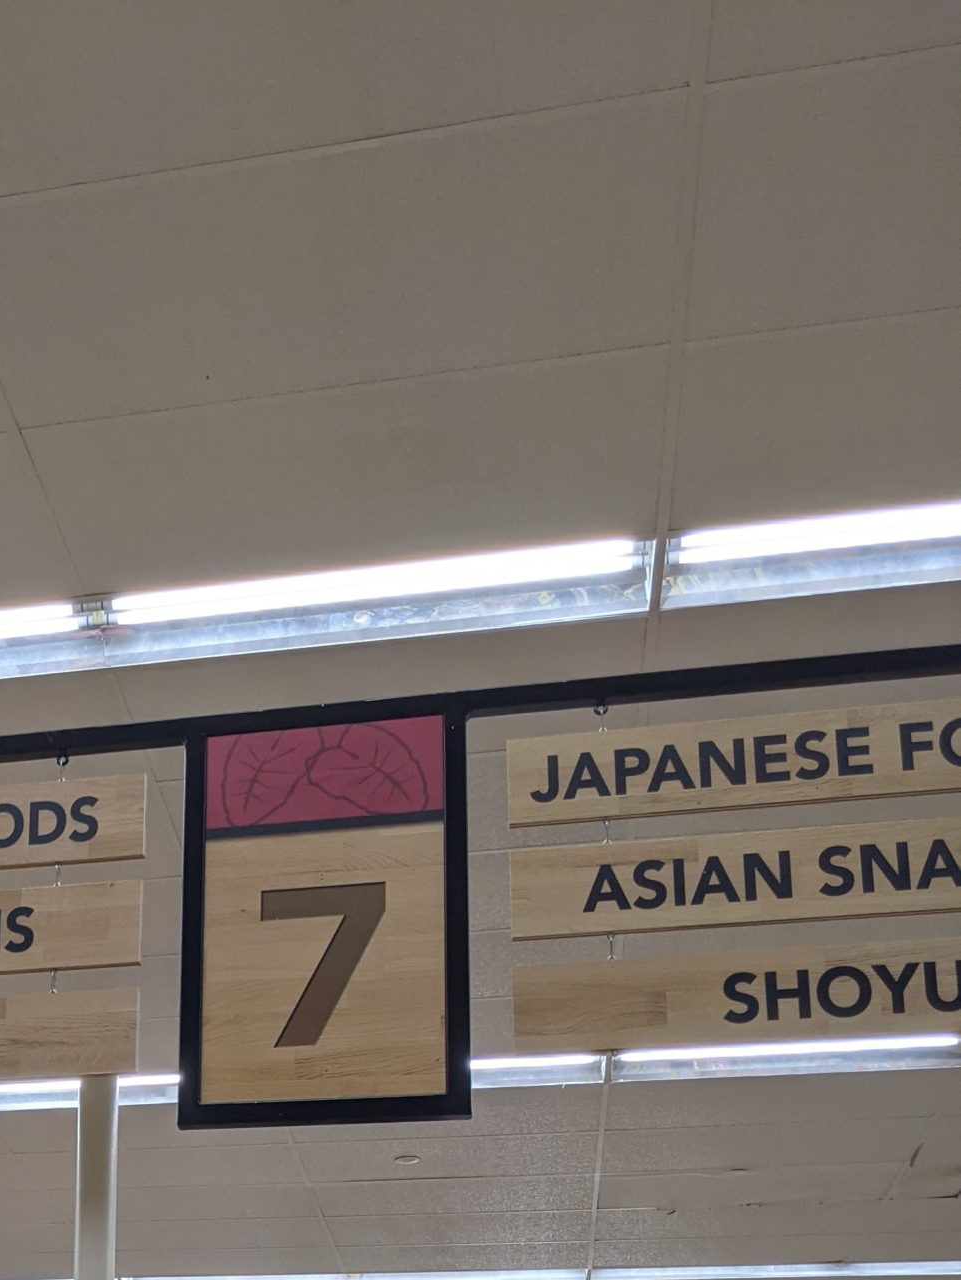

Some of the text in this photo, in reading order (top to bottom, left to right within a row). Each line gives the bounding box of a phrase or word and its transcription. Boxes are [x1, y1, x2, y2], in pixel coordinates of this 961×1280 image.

[529, 726, 874, 804] JAPANESE
[583, 851, 793, 914] ASIAN
[260, 881, 386, 1048] 7
[723, 960, 961, 1024] SHOYU
